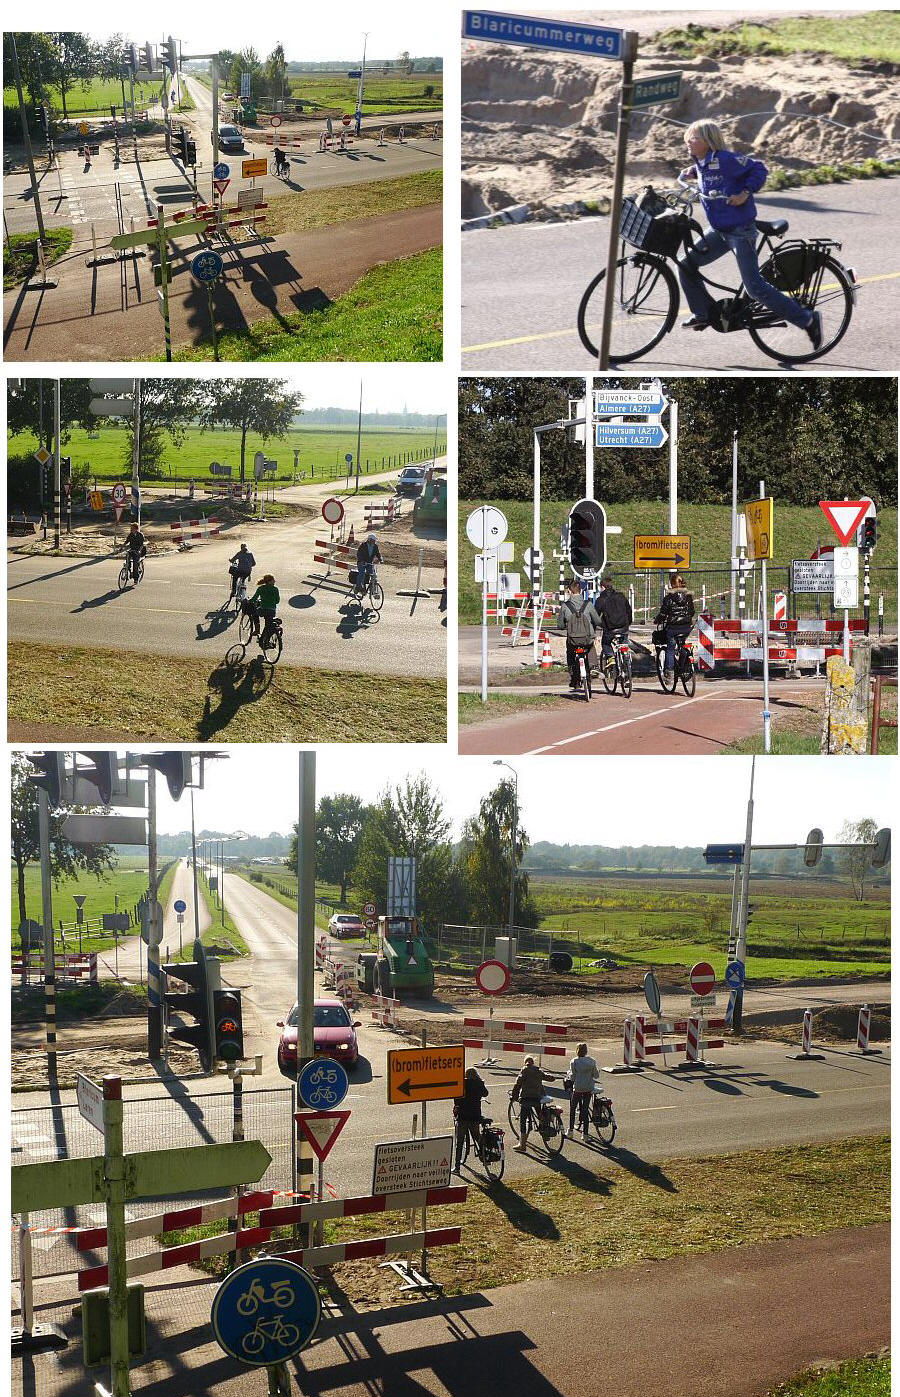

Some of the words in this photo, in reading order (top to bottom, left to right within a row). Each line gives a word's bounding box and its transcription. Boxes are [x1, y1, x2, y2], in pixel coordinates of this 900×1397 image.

[471, 15, 615, 51] Blaricummerweg
[636, 79, 678, 98] Randweg
[600, 394, 653, 403] Bijvanck-Oost
[629, 405, 651, 413] (A27)
[600, 427, 636, 435] Hilversum
[638, 427, 659, 435] (A27)
[600, 436, 628, 444] Utrecht
[630, 436, 652, 444] (A27)
[114, 489, 124, 499] 30
[636, 539, 689, 550] (brom)fietsers
[392, 1055, 462, 1073] (brom)fietsers
[378, 1143, 425, 1155] fietsoversteek
[377, 1156, 406, 1165] gesloten
[388, 1159, 439, 1172] GEVAARLIJK!!
[376, 1173, 411, 1183] Doorrijden
[412, 1171, 427, 1179] naar
[428, 1168, 450, 1177] veilige
[375, 1183, 407, 1192] oversteek
[408, 1178, 447, 1188] Stichtseweg
